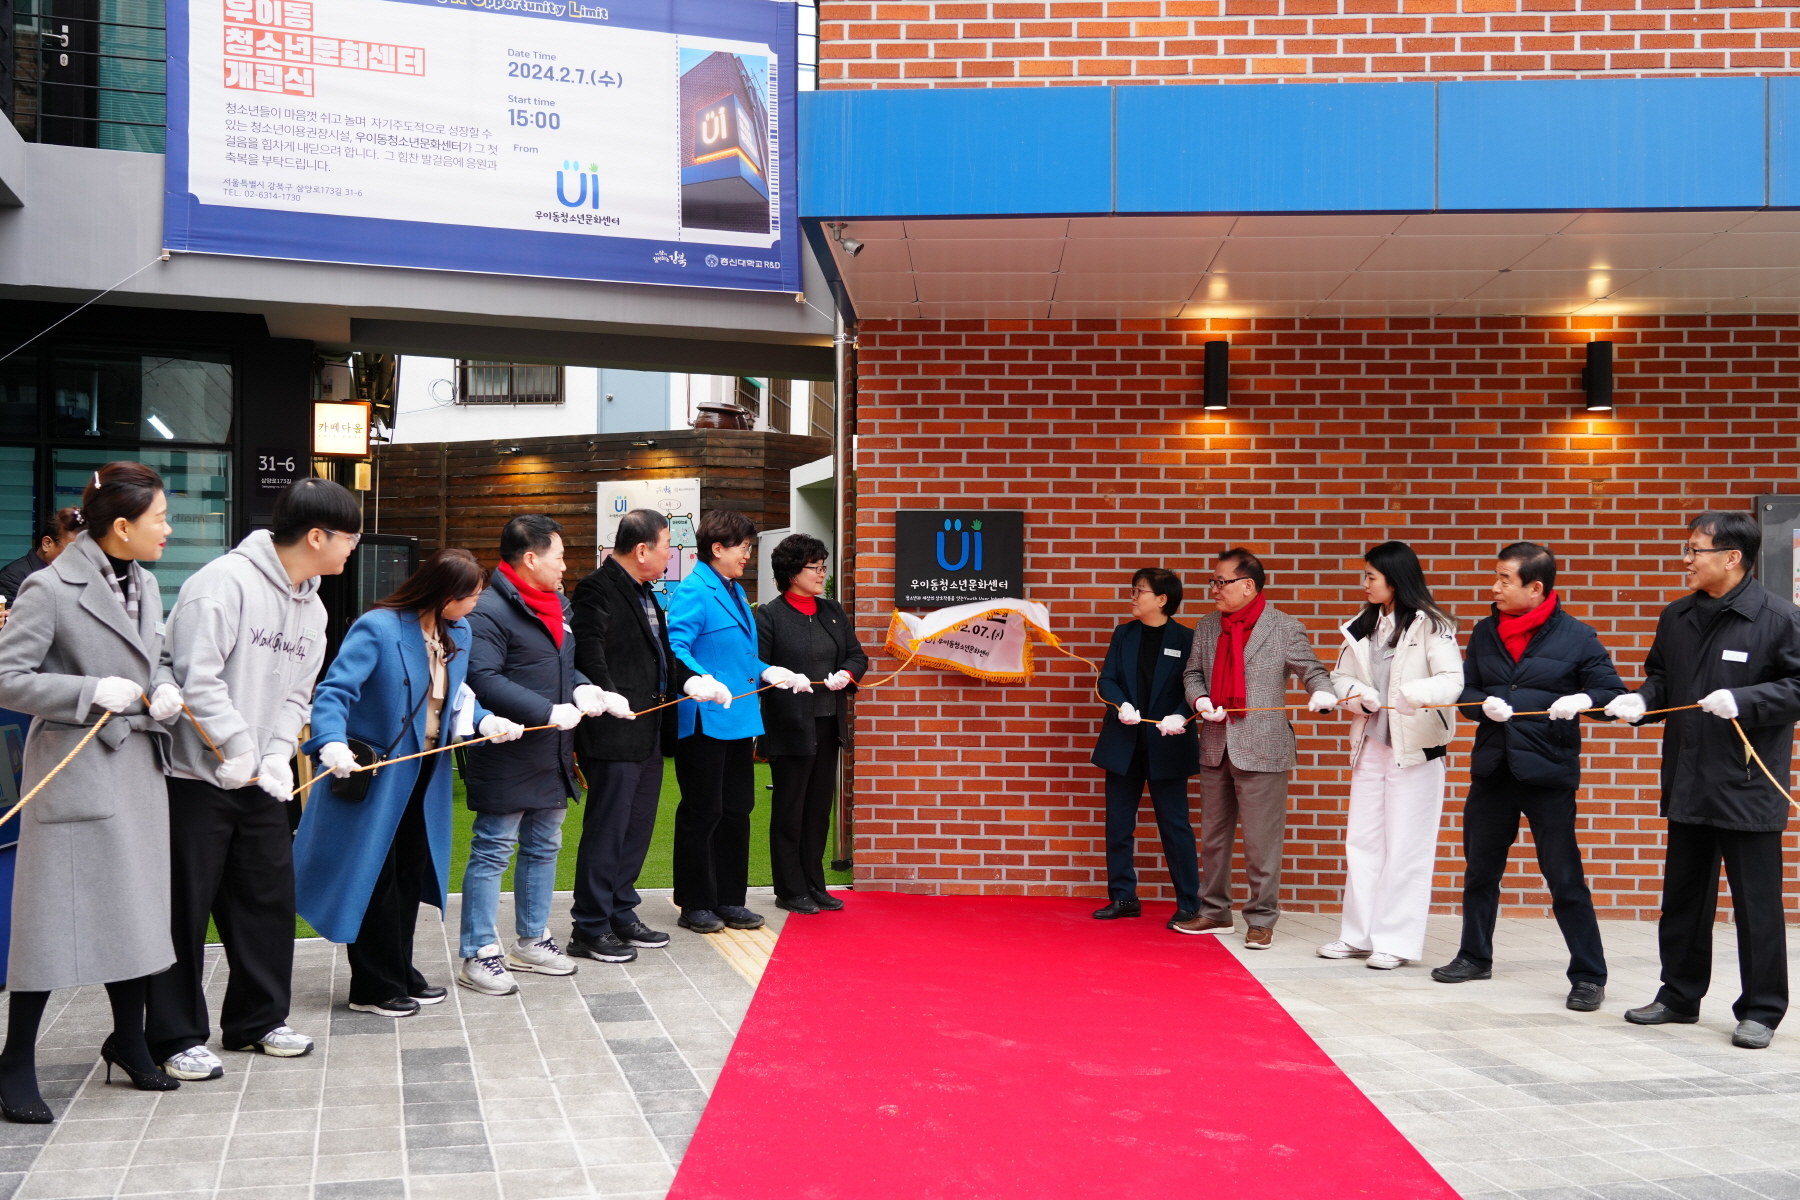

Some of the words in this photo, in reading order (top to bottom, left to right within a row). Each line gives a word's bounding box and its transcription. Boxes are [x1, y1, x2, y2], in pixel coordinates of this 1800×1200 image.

[225, 0, 313, 31] 우이동
[569, 1, 608, 19] Limit
[225, 26, 424, 75] 청소년문화센터
[507, 48, 530, 58] Date
[533, 51, 556, 61] Time
[225, 60, 313, 96] 개관식
[508, 62, 623, 88] 2024.2.7.(수)
[508, 94, 531, 105] Start
[534, 98, 555, 106] time
[225, 102, 281, 119] 청소년들이
[284, 108, 317, 122] 마음껏
[320, 112, 342, 124] 쉬고
[344, 115, 366, 127] 놀며
[371, 117, 446, 134] 자기주도적으로
[448, 125, 479, 138] 성장할
[482, 129, 492, 139] 수
[508, 109, 560, 130] 15:00
[225, 119, 248, 132] 있는
[250, 121, 352, 143] 청소년이용권장시설,
[355, 131, 472, 153] 우이동청소년문화센터가
[475, 144, 485, 153] 그
[488, 144, 498, 155] 첫
[225, 135, 258, 150] 걸음을
[262, 138, 295, 152] 힘차게
[344, 147, 379, 160] 합니다.
[384, 150, 395, 160] 그
[398, 151, 419, 163] 힘찬
[421, 153, 464, 168] 발걸음에
[466, 157, 497, 171] 응원과
[513, 144, 539, 154] From
[225, 152, 259, 166] 축복을
[262, 155, 331, 172] 부탁드립니다.
[222, 178, 265, 189] 서울특별시
[267, 181, 293, 192] 강북구
[345, 188, 363, 197] 31-6
[222, 188, 241, 197] TEL.
[244, 190, 301, 202] 02-6314-1730
[535, 210, 620, 226] 우이동청소년문화센터
[764, 261, 781, 269] R&D
[258, 455, 295, 472] 31-6
[910, 578, 1009, 592] 우이동청소년문화센터
